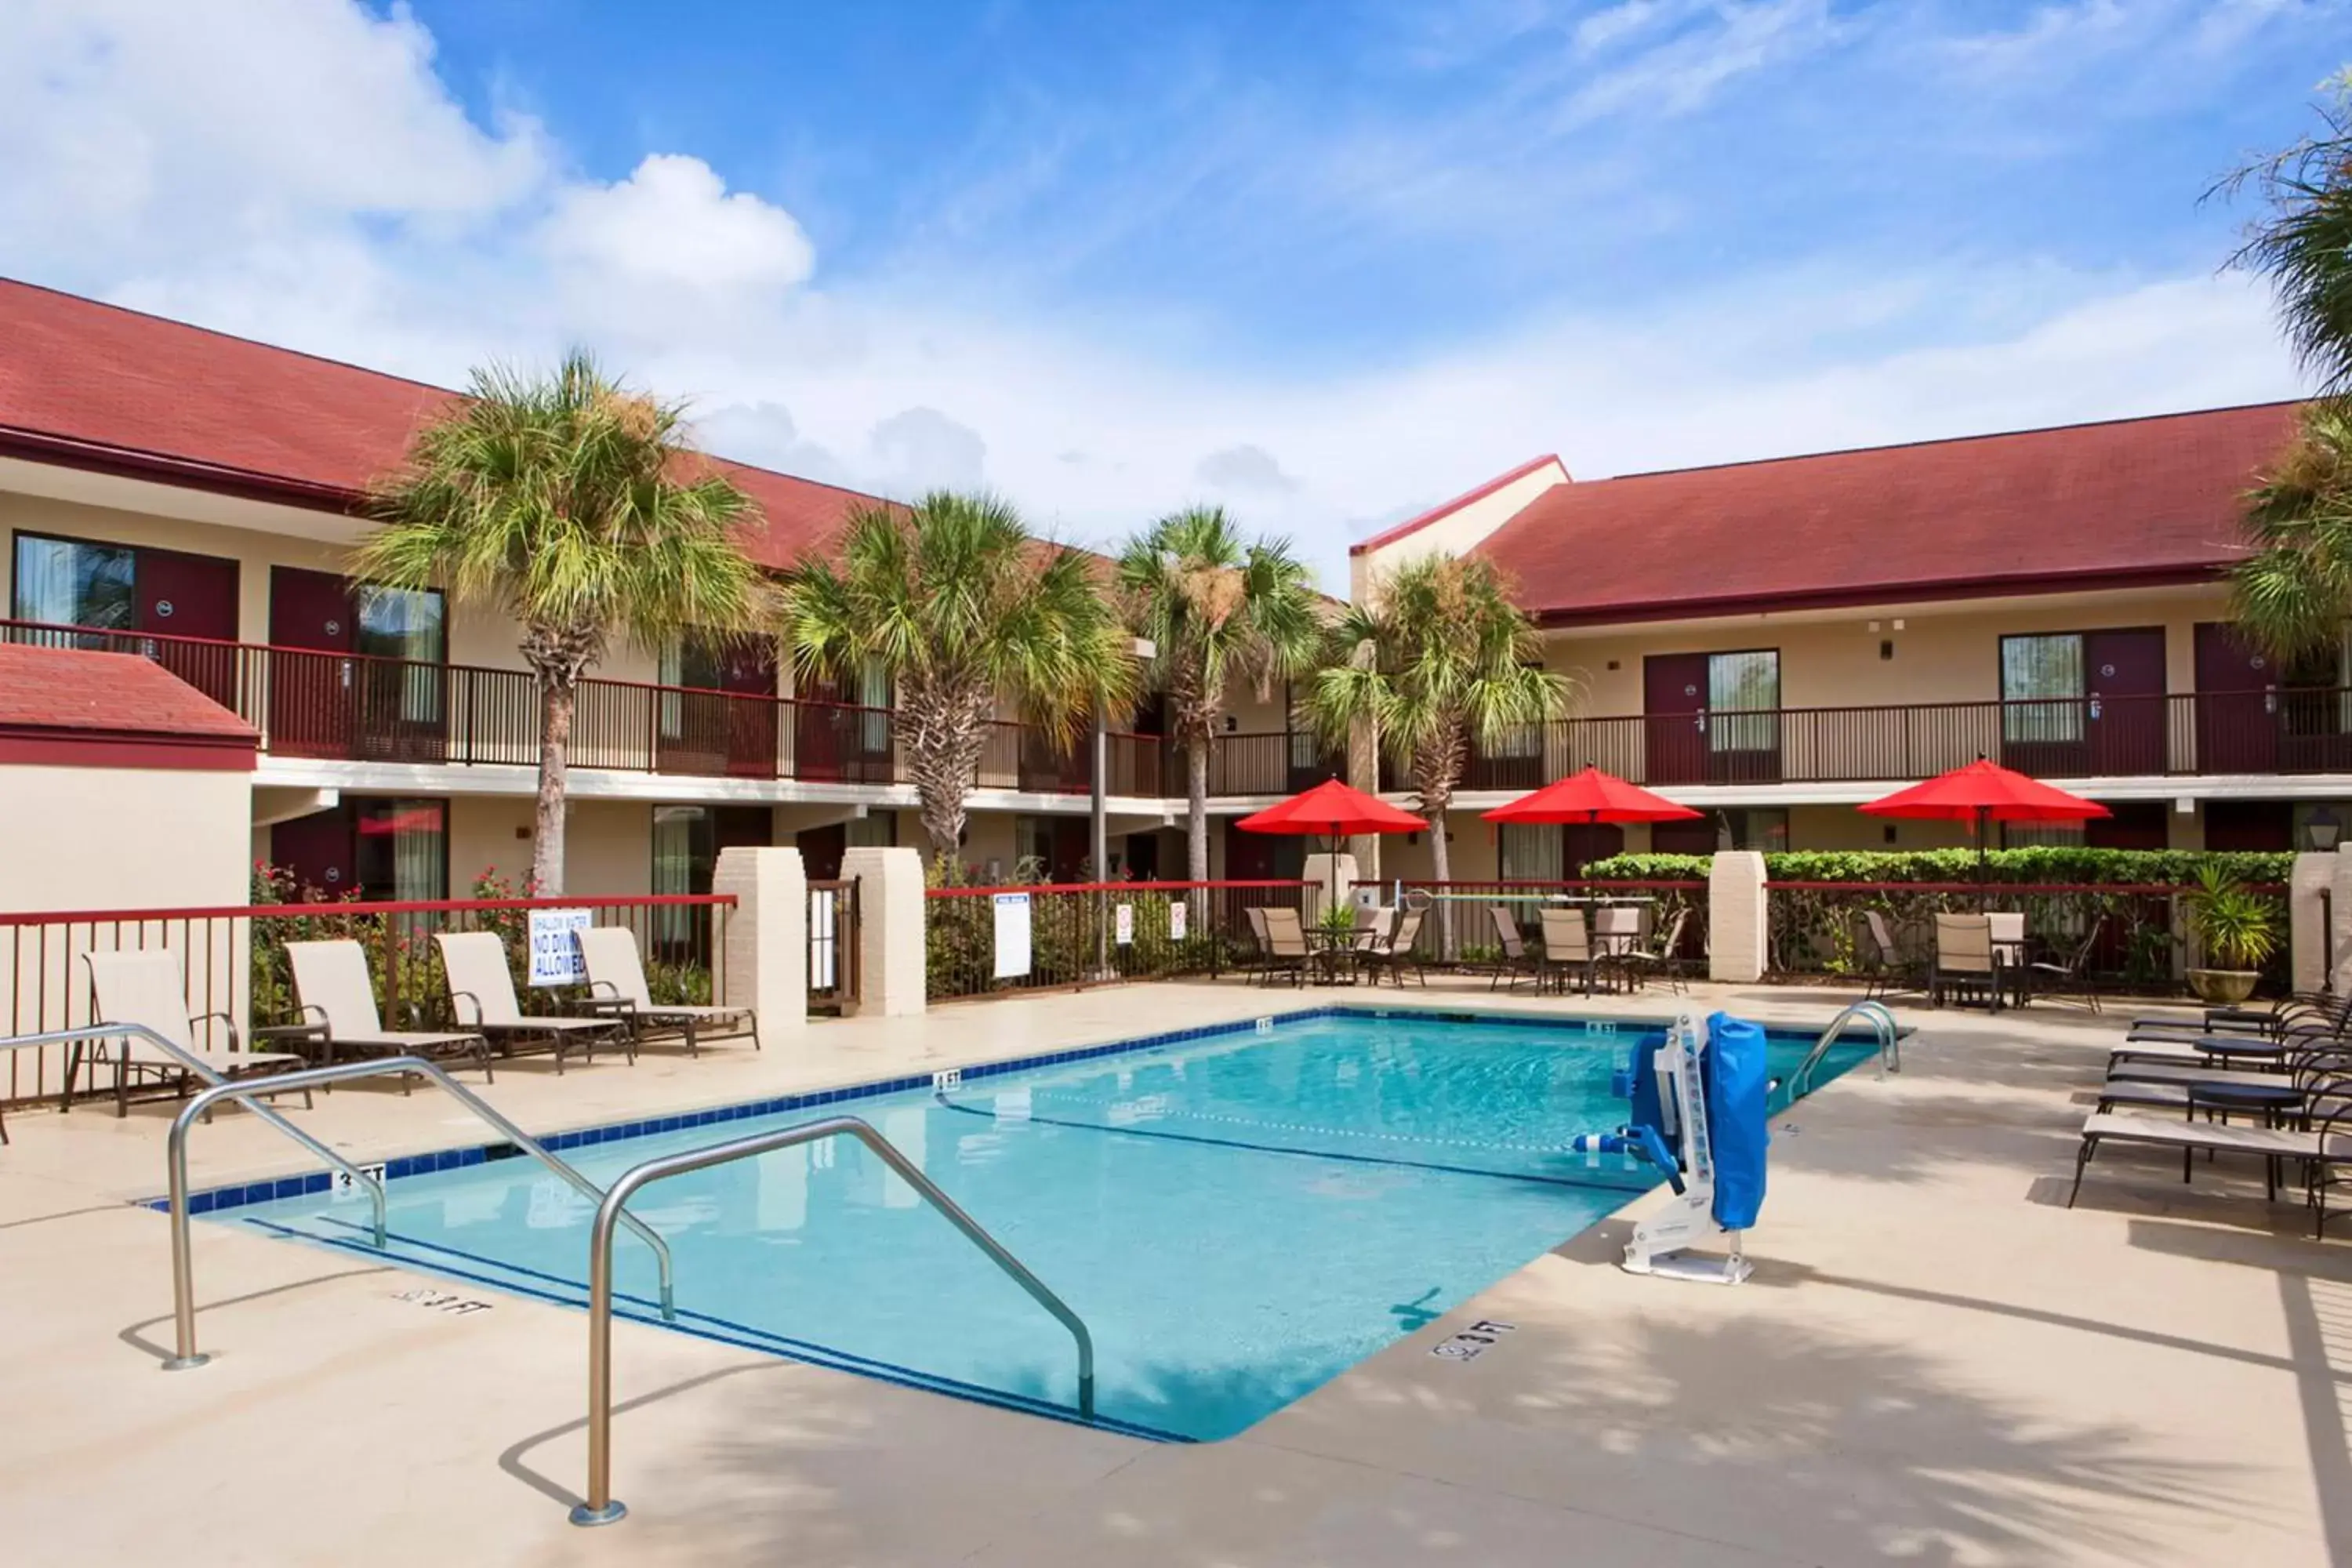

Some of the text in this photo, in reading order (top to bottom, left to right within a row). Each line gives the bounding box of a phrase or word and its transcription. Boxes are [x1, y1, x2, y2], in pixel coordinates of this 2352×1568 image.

[534, 933, 581, 954] NO DIVIN
[535, 954, 586, 976] ALLOWED
